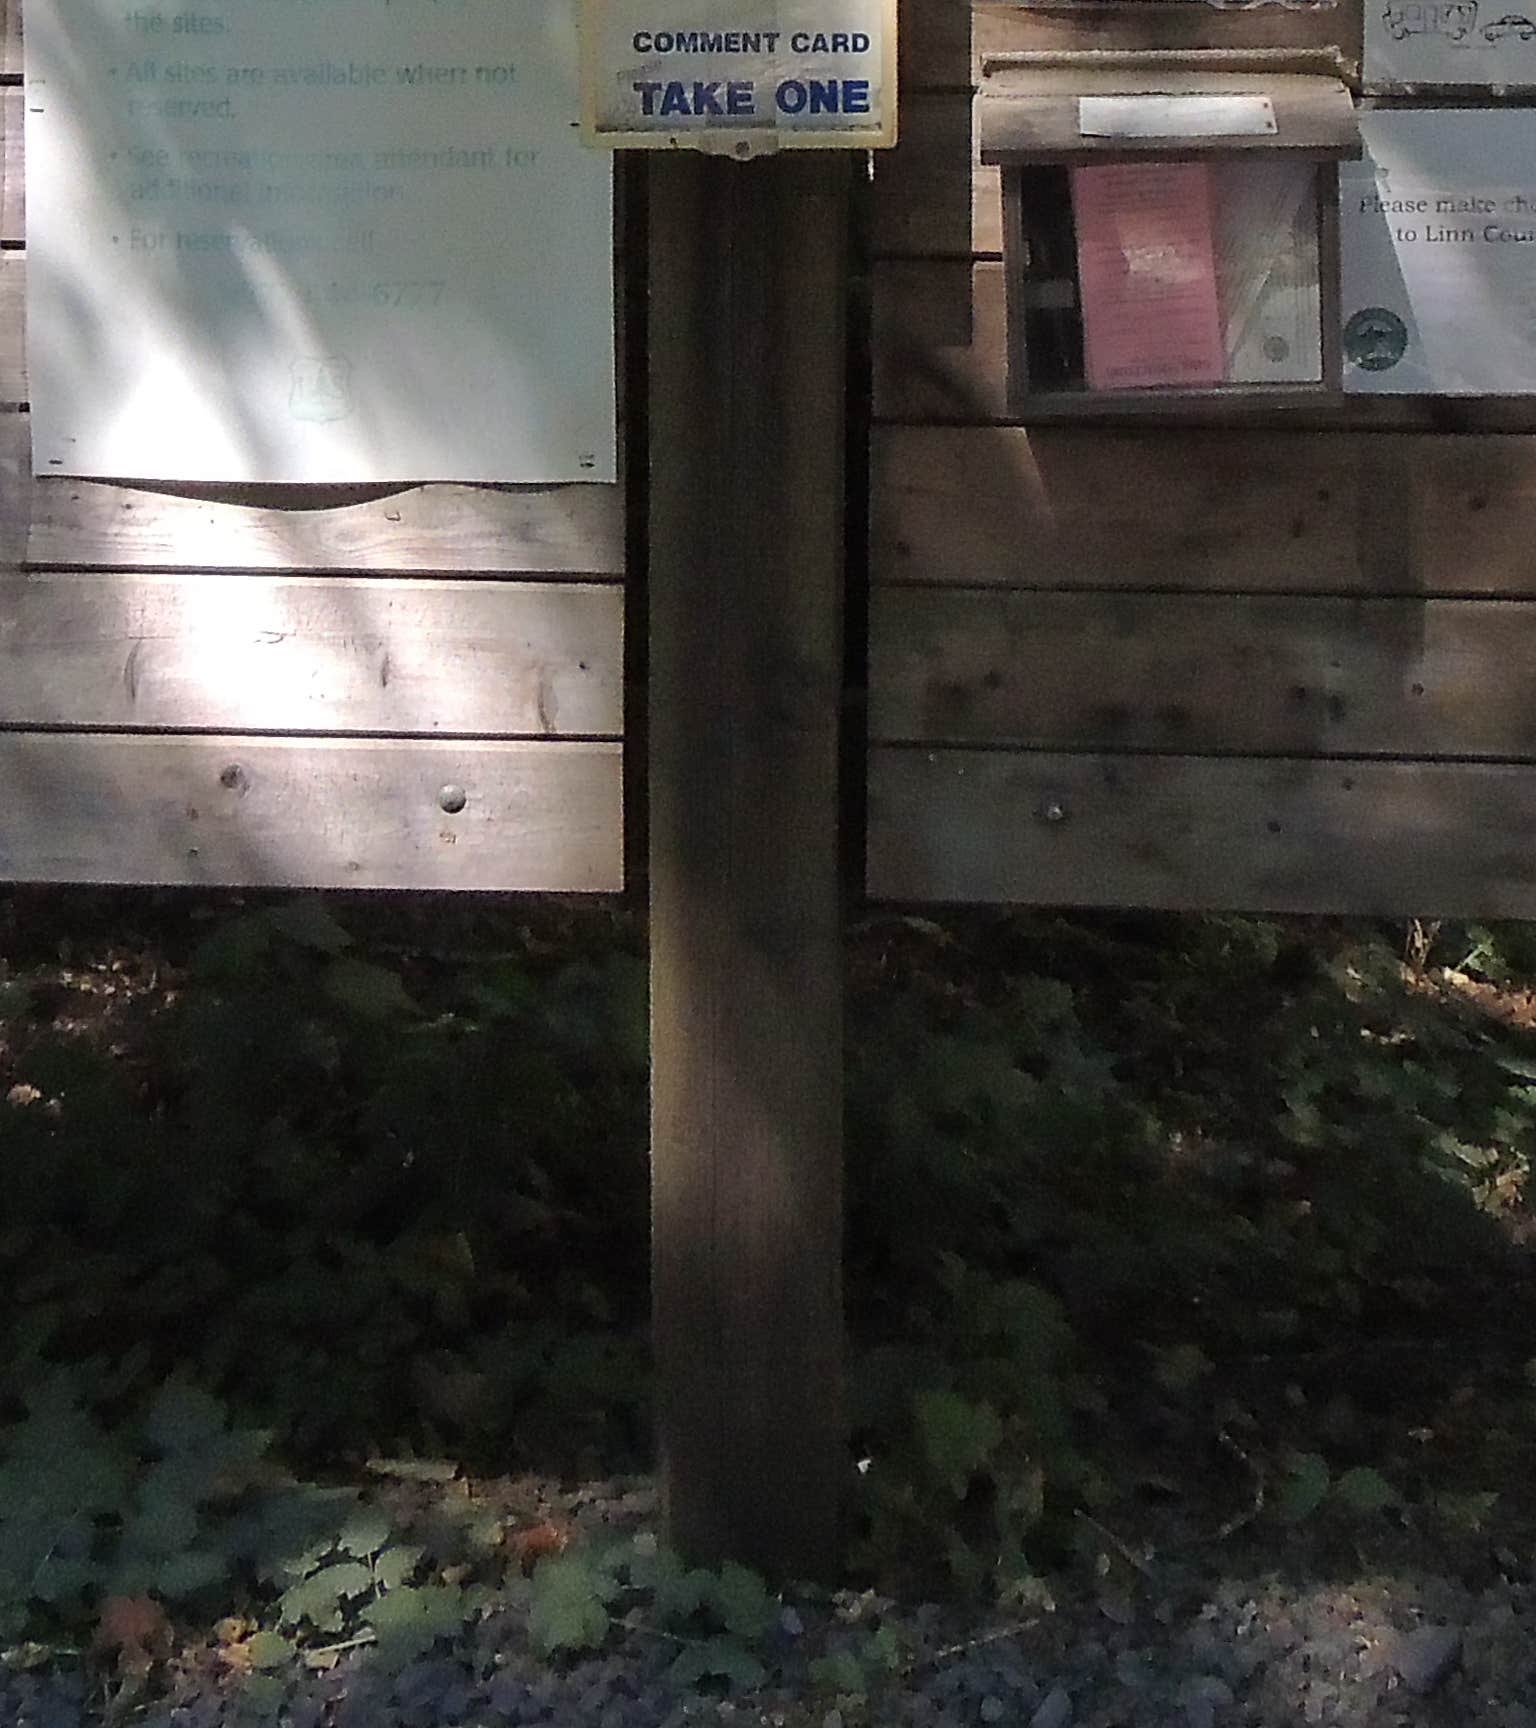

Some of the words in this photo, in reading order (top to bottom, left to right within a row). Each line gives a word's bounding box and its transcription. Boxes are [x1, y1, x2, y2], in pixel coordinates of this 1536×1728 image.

[633, 31, 780, 54] COMMENT
[791, 32, 870, 54] CARD
[633, 81, 756, 116] TAKE
[775, 80, 870, 114] ONE
[1359, 196, 1428, 214] Please
[1436, 196, 1496, 214] make
[1396, 226, 1417, 242] to
[1426, 225, 1475, 243] Linn
